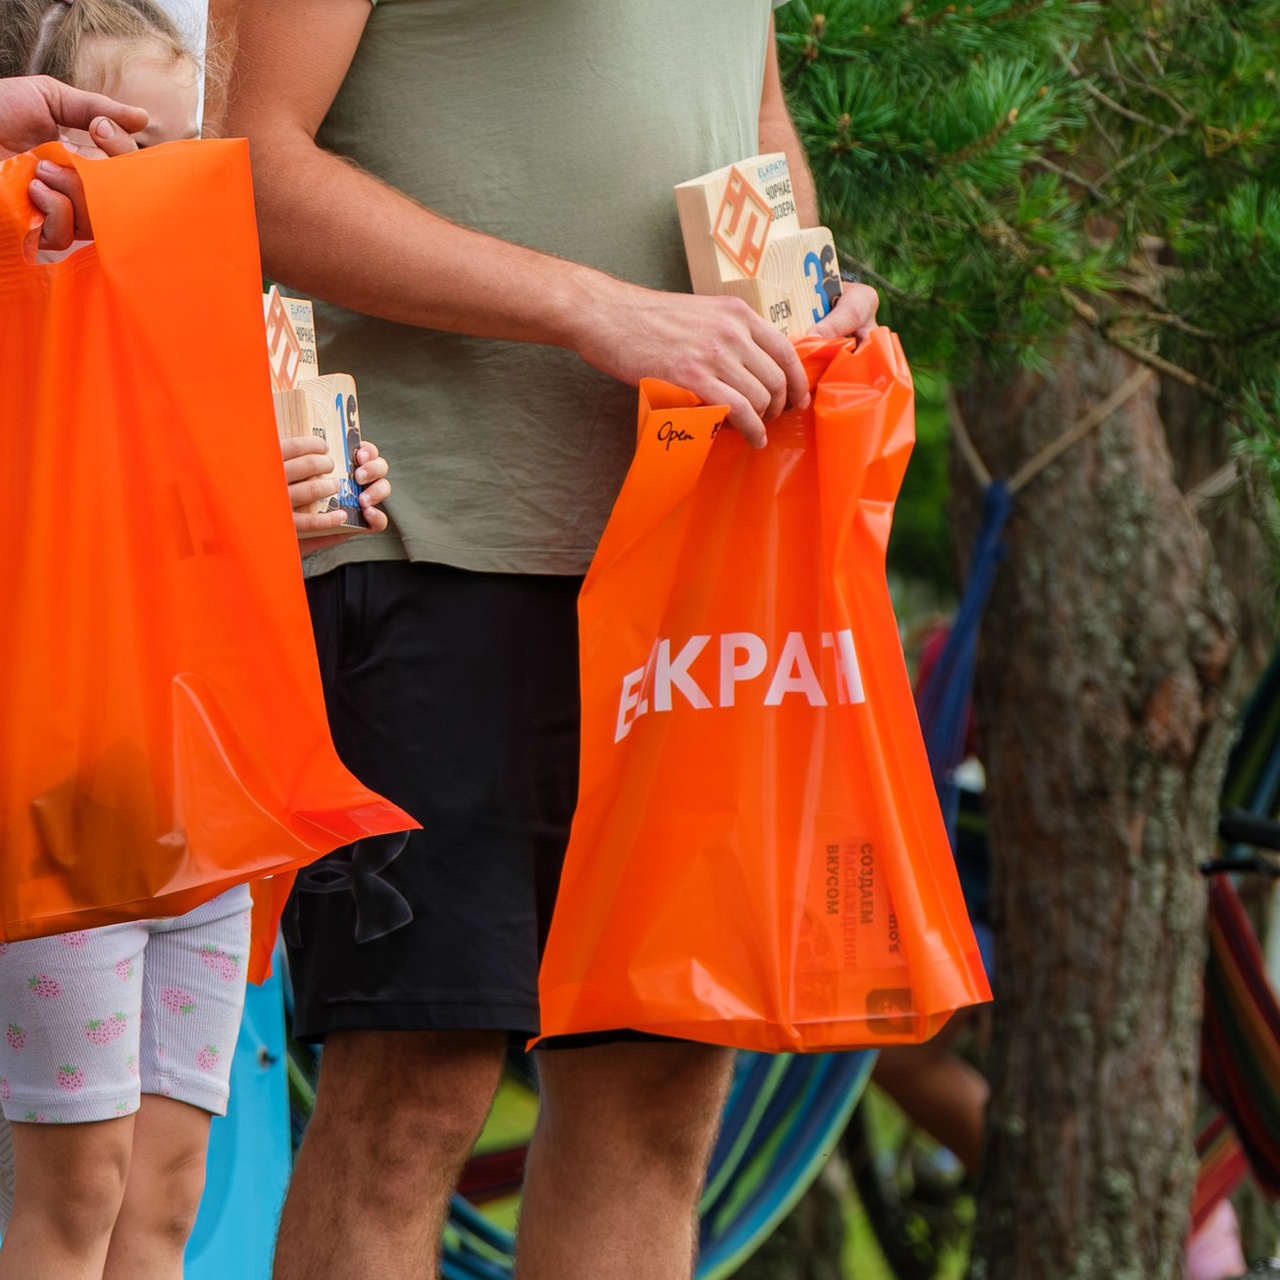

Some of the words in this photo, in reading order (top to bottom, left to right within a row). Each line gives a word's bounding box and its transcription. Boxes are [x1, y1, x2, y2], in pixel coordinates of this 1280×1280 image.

[765, 178, 792, 200] ЧОРНАЕ
[770, 299, 792, 323] OPEN
[804, 251, 831, 324] 3
[335, 392, 351, 474] 1
[657, 420, 695, 451] Open
[826, 843, 840, 916] ВКУСОМ
[859, 842, 874, 925] СОЗДАЕМ
